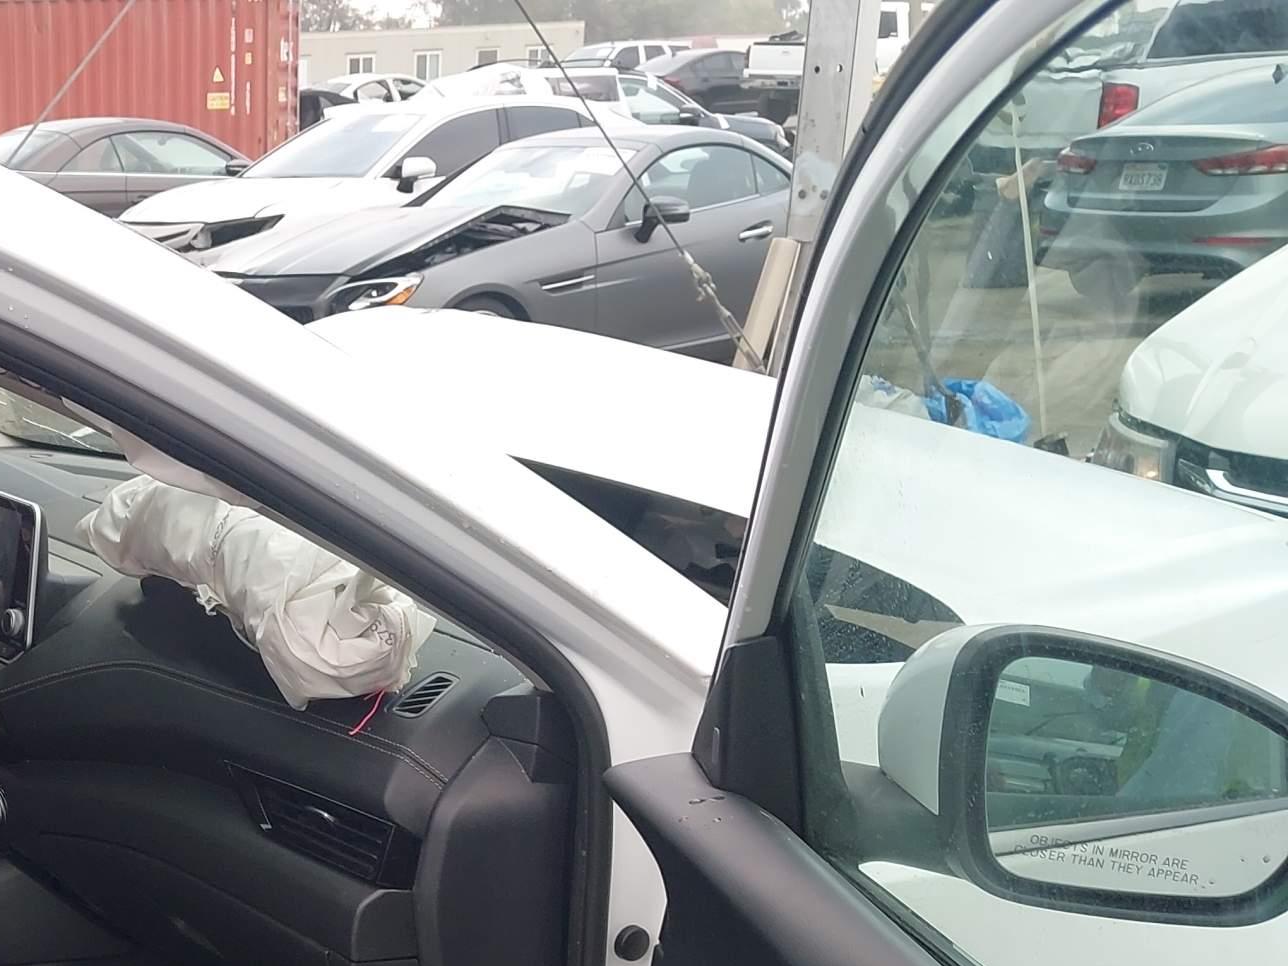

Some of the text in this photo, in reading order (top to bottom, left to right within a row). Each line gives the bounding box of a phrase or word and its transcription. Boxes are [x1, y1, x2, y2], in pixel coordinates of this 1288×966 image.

[1014, 844, 1199, 886] CLOSER THAN THEY APPEAR
[1030, 834, 1190, 871] OBJECTS IN MIRROR ARE
